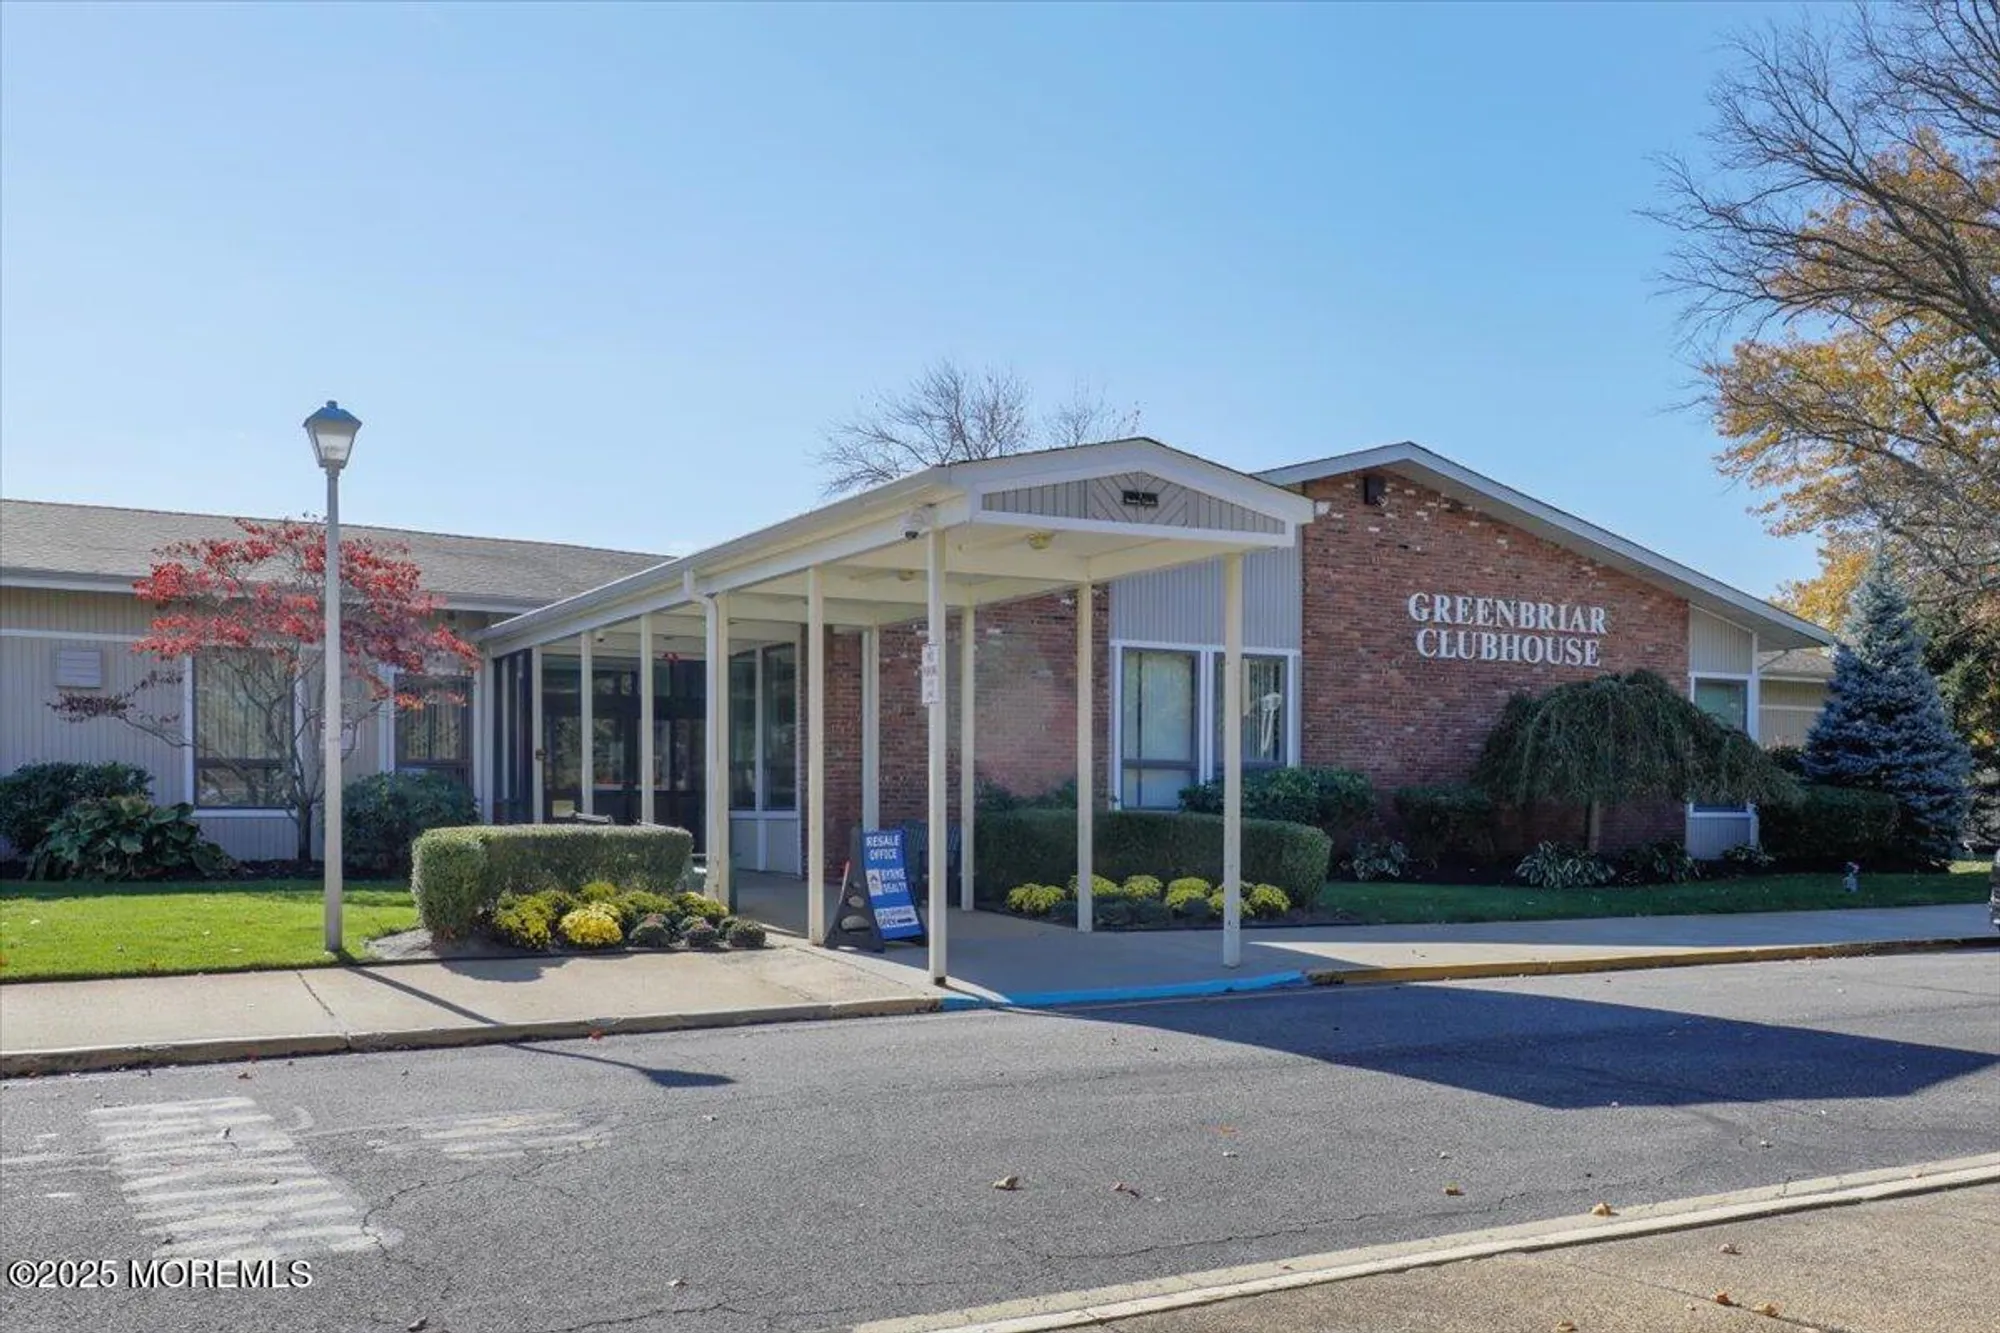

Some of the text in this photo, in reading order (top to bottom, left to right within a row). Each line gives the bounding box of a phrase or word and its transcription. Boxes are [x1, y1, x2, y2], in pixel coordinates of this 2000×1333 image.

[1408, 592, 1608, 634] GREENBRIAR
[1416, 628, 1600, 667] CLUBHOUSE
[866, 835, 900, 847] RESALE
[869, 848, 897, 860] OFFICE
